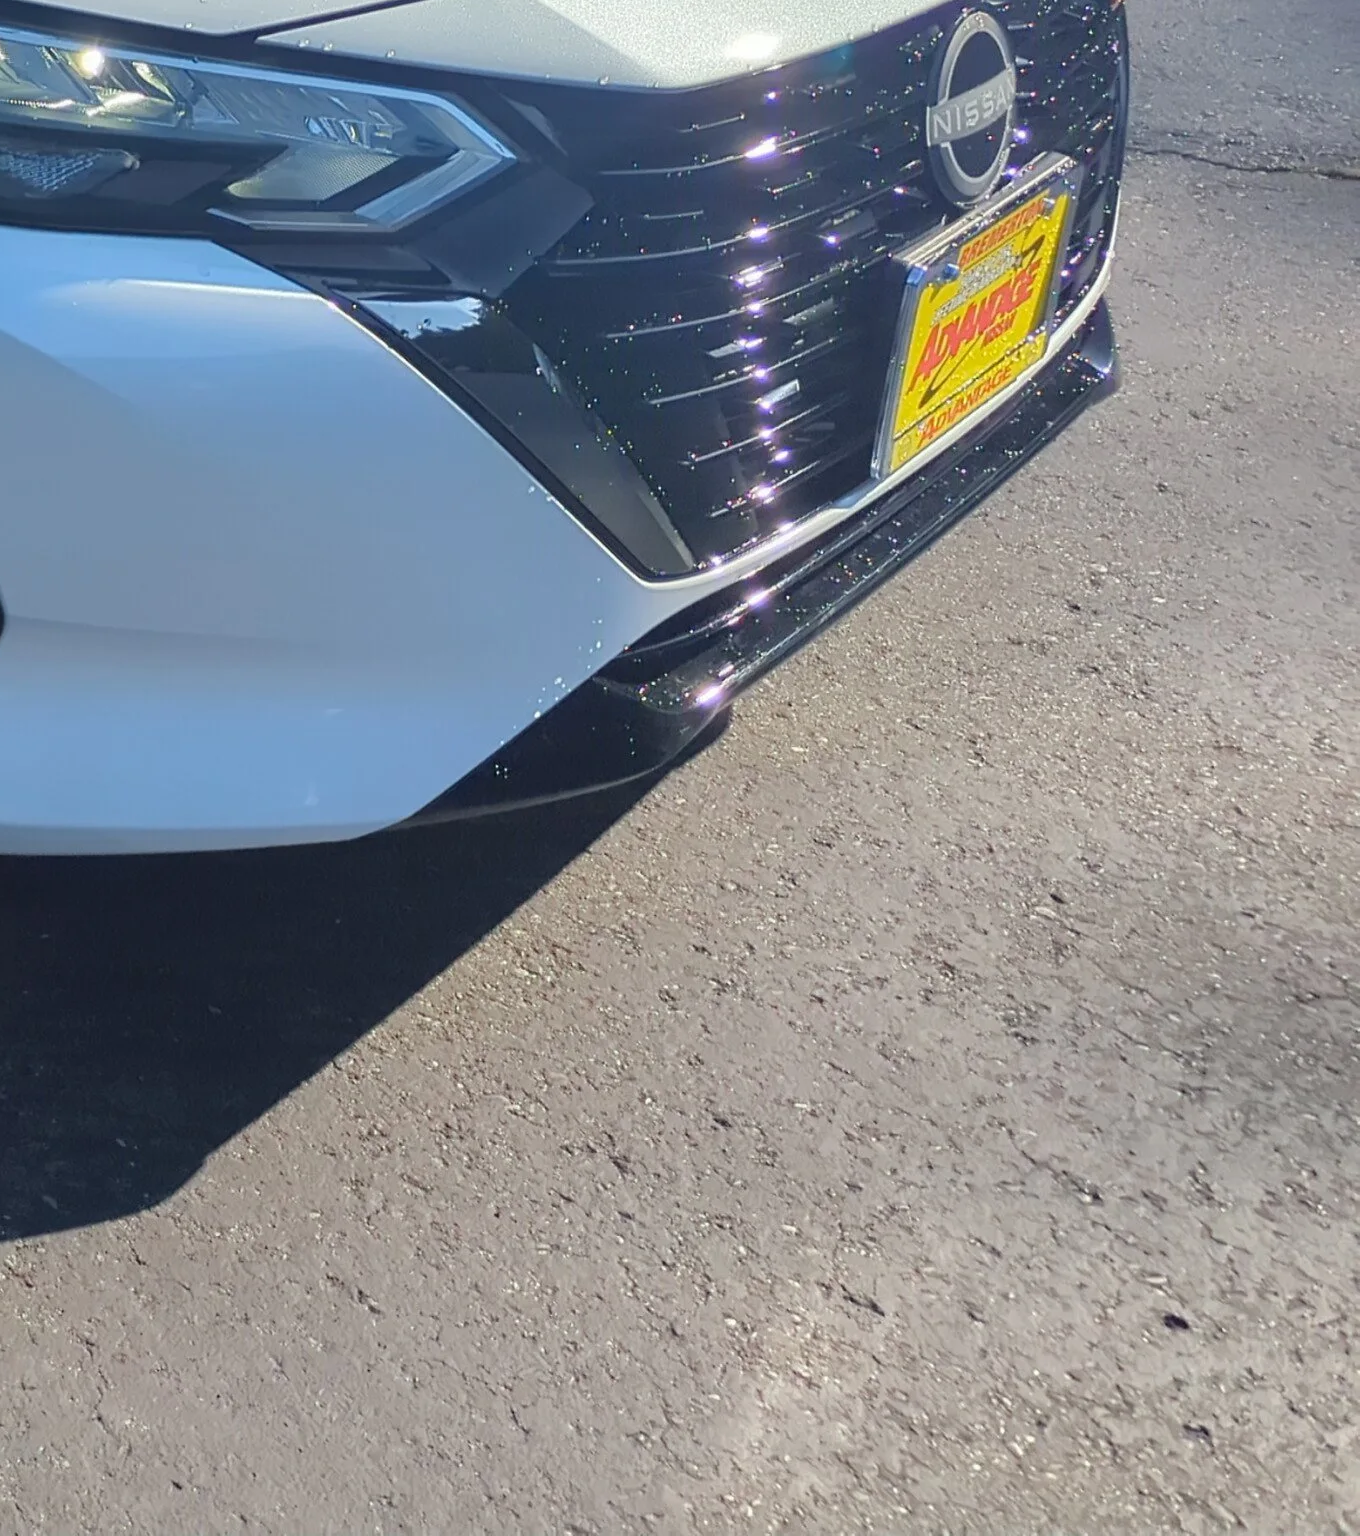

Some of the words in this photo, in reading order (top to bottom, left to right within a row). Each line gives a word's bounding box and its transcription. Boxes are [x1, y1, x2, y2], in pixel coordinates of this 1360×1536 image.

[932, 68, 1015, 139] NISSAN
[907, 258, 1043, 396] ADVANTAGE
[917, 364, 1012, 449] ADVANTAGE
